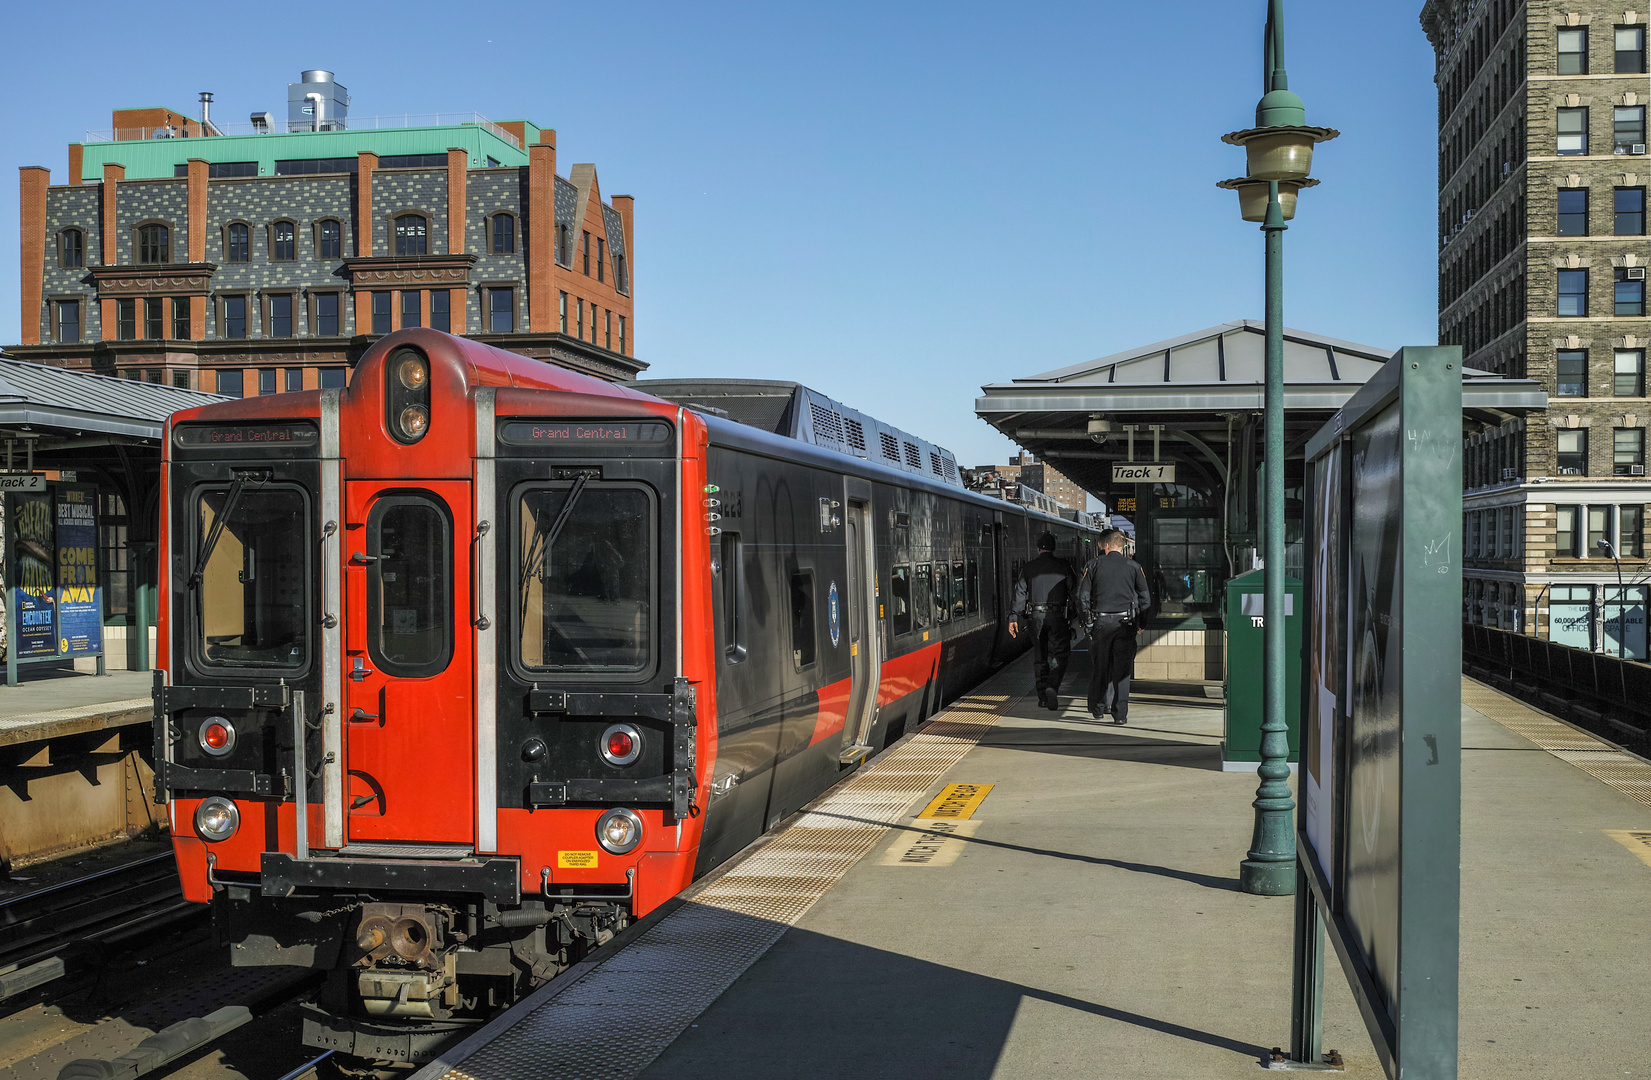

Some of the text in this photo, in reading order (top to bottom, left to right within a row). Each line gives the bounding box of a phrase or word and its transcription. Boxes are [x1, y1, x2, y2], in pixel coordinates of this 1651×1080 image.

[211, 430, 243, 442] Grand
[248, 429, 291, 441] Central
[532, 427, 627, 439] Grand Central
[1114, 466, 1164, 478] Track 1
[0, 477, 38, 487] rack 2
[58, 503, 94, 518] BEST MUSICAL
[60, 547, 95, 565] COME
[60, 565, 96, 584] FROM
[60, 584, 96, 603] AWAY
[1562, 624, 1631, 632] OFFICE SPAE
